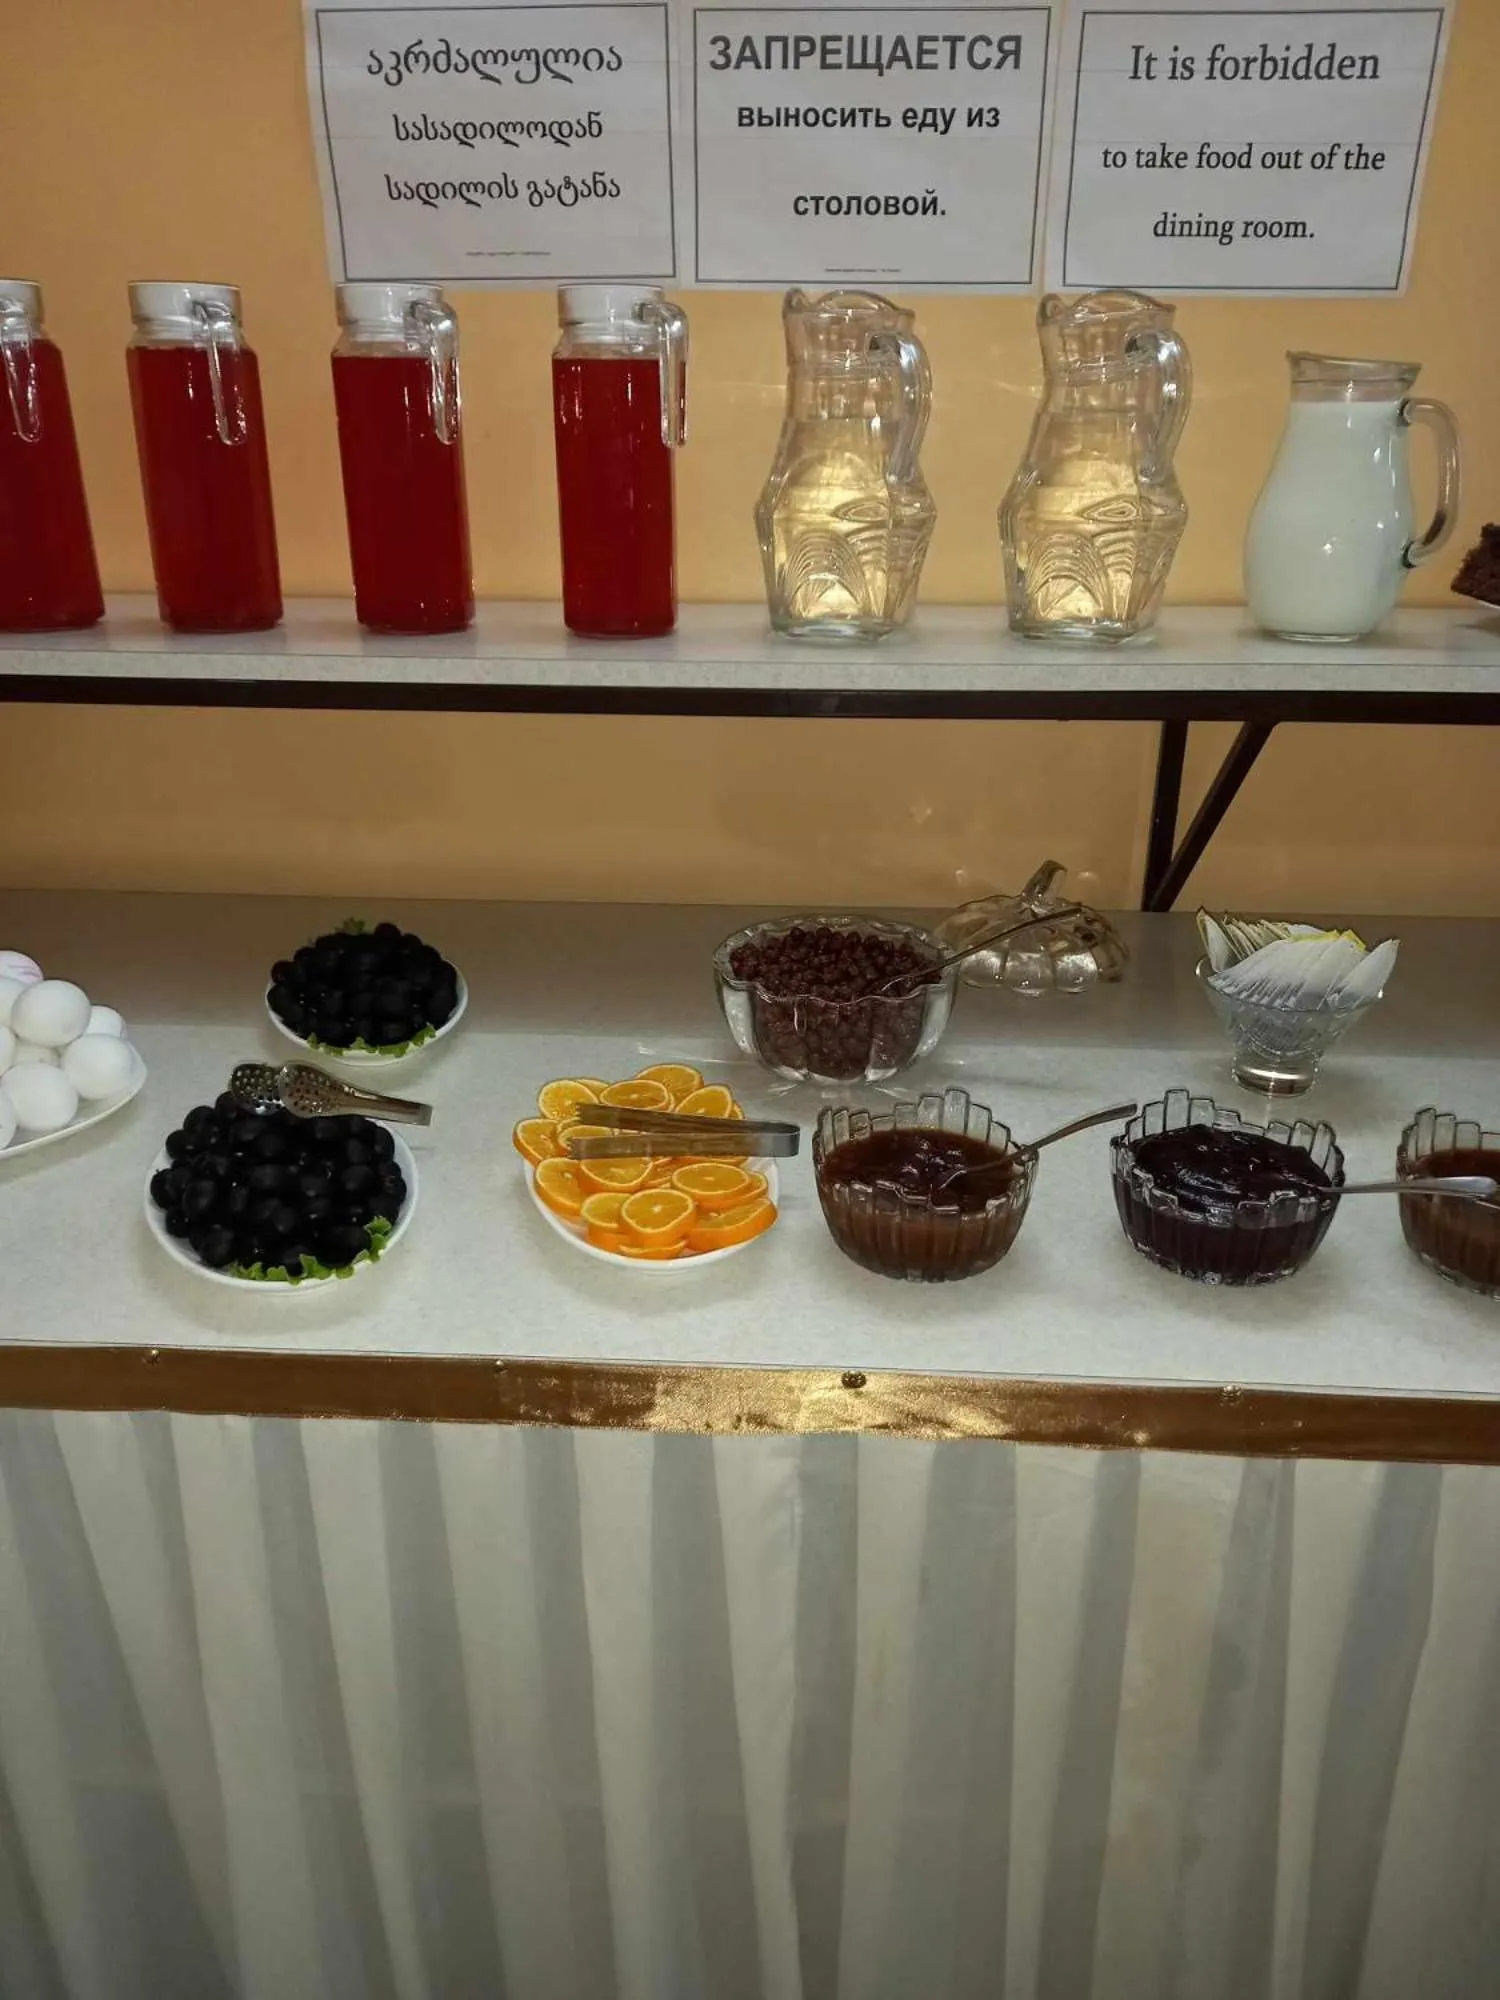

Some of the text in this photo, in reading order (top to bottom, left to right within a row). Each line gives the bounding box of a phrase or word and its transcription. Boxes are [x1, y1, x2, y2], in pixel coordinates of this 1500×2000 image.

[366, 37, 623, 87] აკრძალულია
[709, 34, 1023, 78] ЗАПРЕЩАЕТСЯ
[1127, 42, 1381, 82] It is forbidden
[391, 110, 604, 150] სასადილოდან
[737, 106, 1001, 136] выносить еду из
[1101, 141, 1386, 171] to take food out of the
[383, 170, 621, 210] სადილის გატანა
[792, 188, 947, 217] столовой.
[1152, 211, 1315, 247] dining room.
